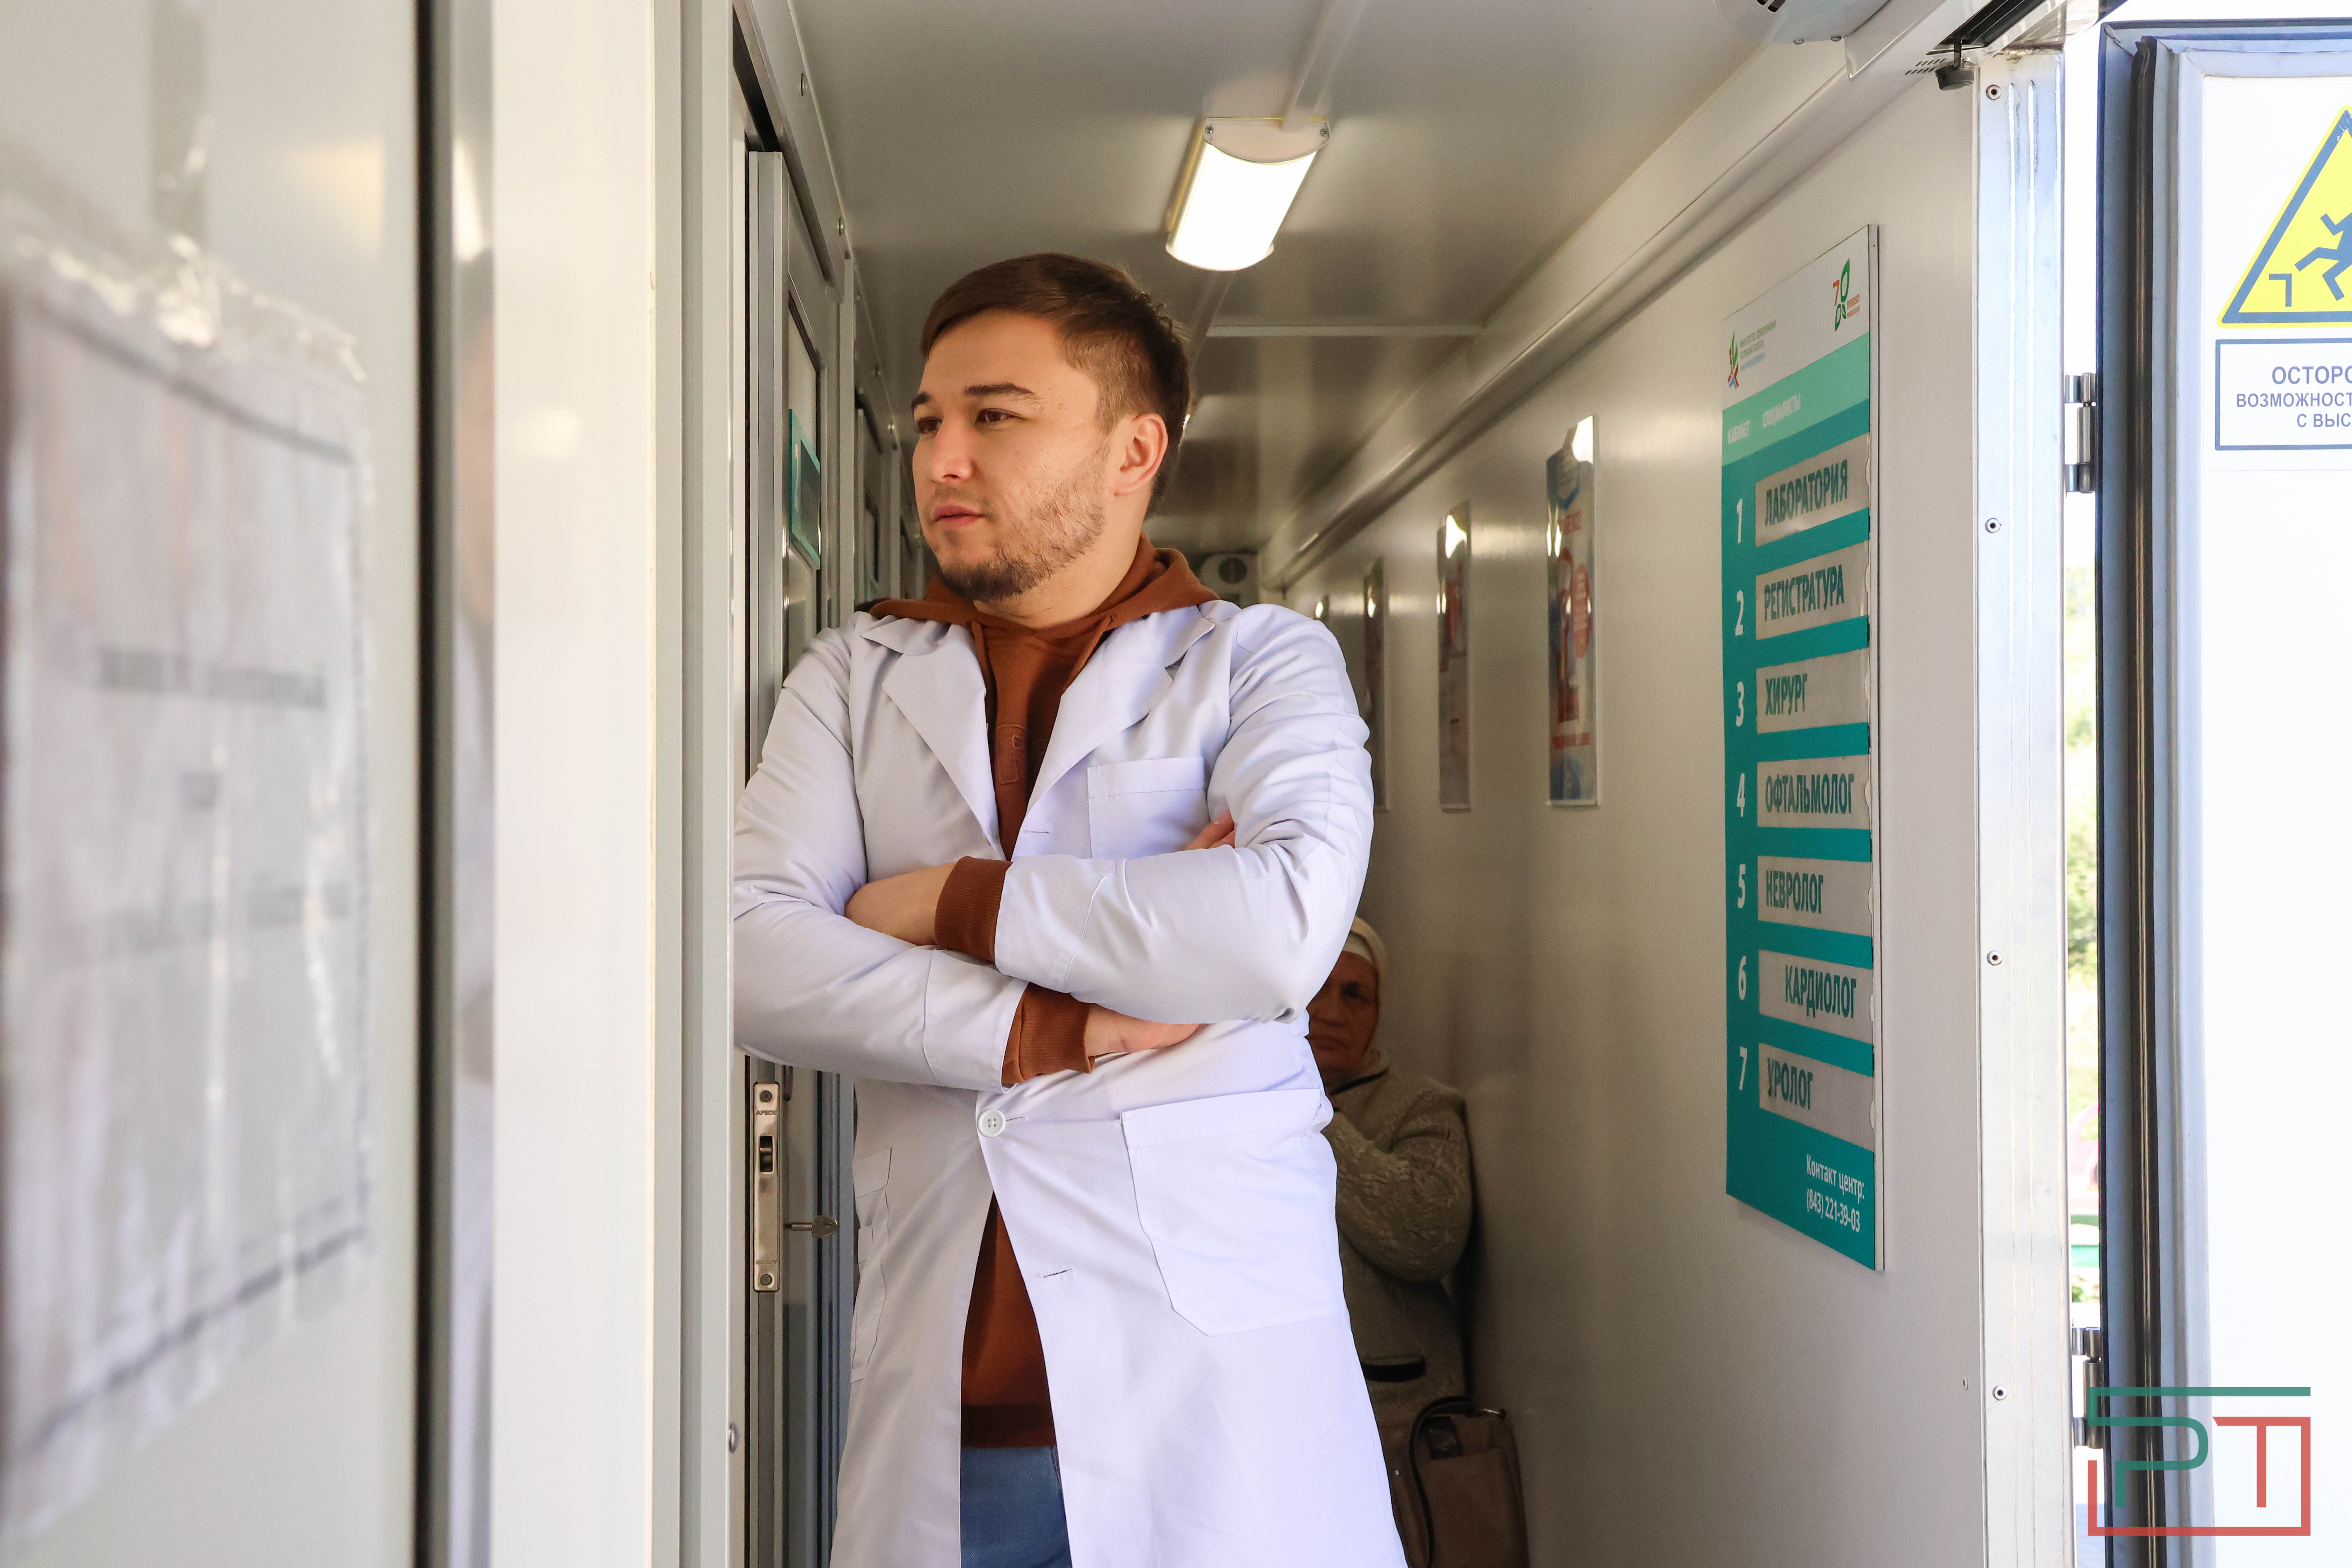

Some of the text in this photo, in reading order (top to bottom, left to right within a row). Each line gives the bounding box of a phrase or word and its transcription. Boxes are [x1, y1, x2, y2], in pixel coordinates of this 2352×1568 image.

[2297, 413, 2351, 428] С ВЫС
[1736, 459, 1848, 543] 1 ЛАБОРАТОРИЯ
[1735, 564, 1845, 636] 2 РЕГИСТРАТУРА
[1736, 673, 1808, 727] 3 ХИРУРГ
[1736, 773, 1854, 817] 4 ОФТАЛЬМОЛОГ
[1738, 864, 1824, 914] 5 НЕВРОЛОГ
[1738, 955, 1857, 1018] 6 КАРДИОЛОГ
[1739, 1046, 1813, 1109] 7 УРОЛОГ
[1807, 1154, 1864, 1204] Контакт центр:
[1807, 1188, 1860, 1232] (843) 221-39-03
